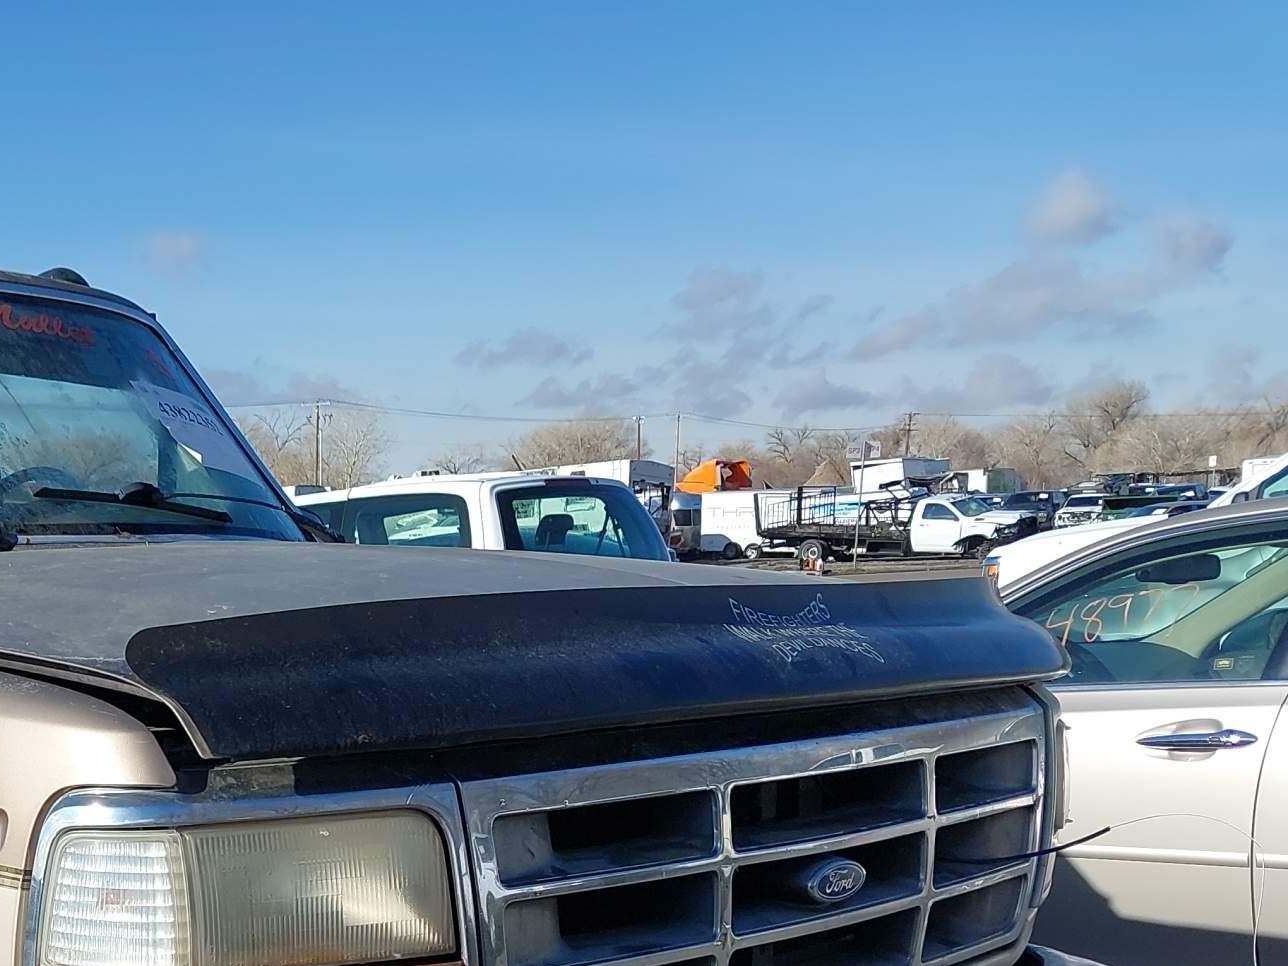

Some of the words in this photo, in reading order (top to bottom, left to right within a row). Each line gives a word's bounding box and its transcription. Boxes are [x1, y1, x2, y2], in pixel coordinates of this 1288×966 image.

[728, 592, 831, 627] FIREFIGHTERS
[723, 623, 774, 643] WALK
[772, 638, 813, 663] DEVIL
[813, 637, 885, 664] DANCES
[825, 869, 856, 893] Ford
